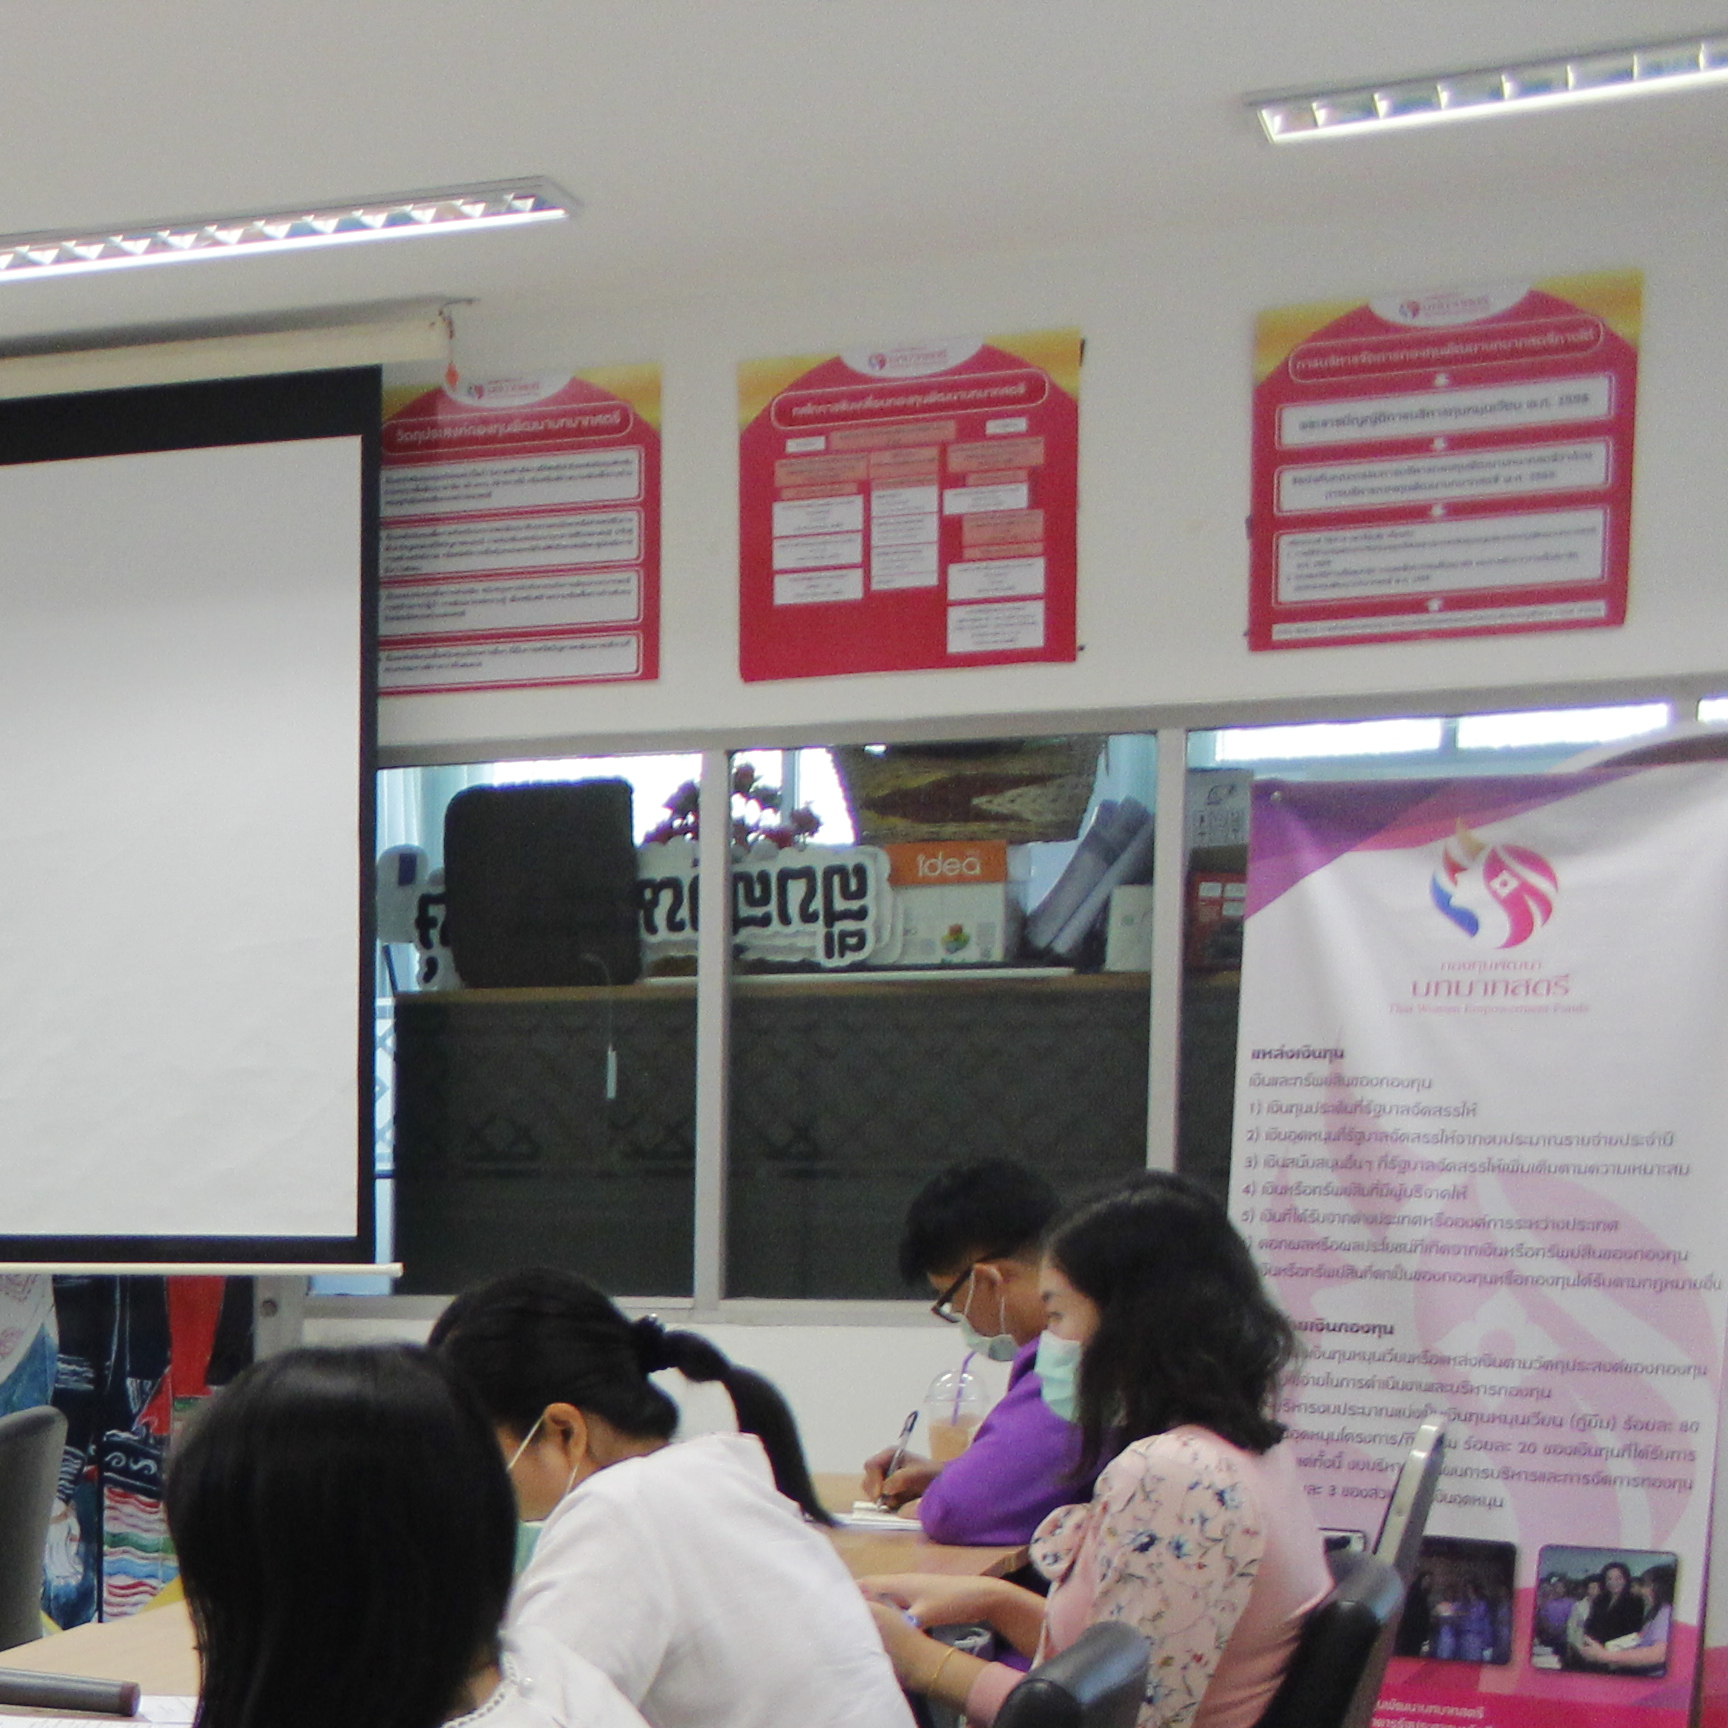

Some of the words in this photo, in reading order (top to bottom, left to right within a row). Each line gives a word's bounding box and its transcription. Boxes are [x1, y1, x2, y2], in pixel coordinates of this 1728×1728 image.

[1411, 974, 1571, 998] บทบาทสตรี
[1251, 1044, 1345, 1062] แหล่งเงินทุน
[1246, 1130, 1259, 1143] 2)
[1244, 1157, 1257, 1170] 3)
[1242, 1183, 1256, 1196] 4)
[1623, 1416, 1672, 1432] ร้อยละ
[1679, 1421, 1700, 1433] 80
[1463, 1435, 1511, 1451] ร้อยละ
[1518, 1442, 1536, 1454] 20
